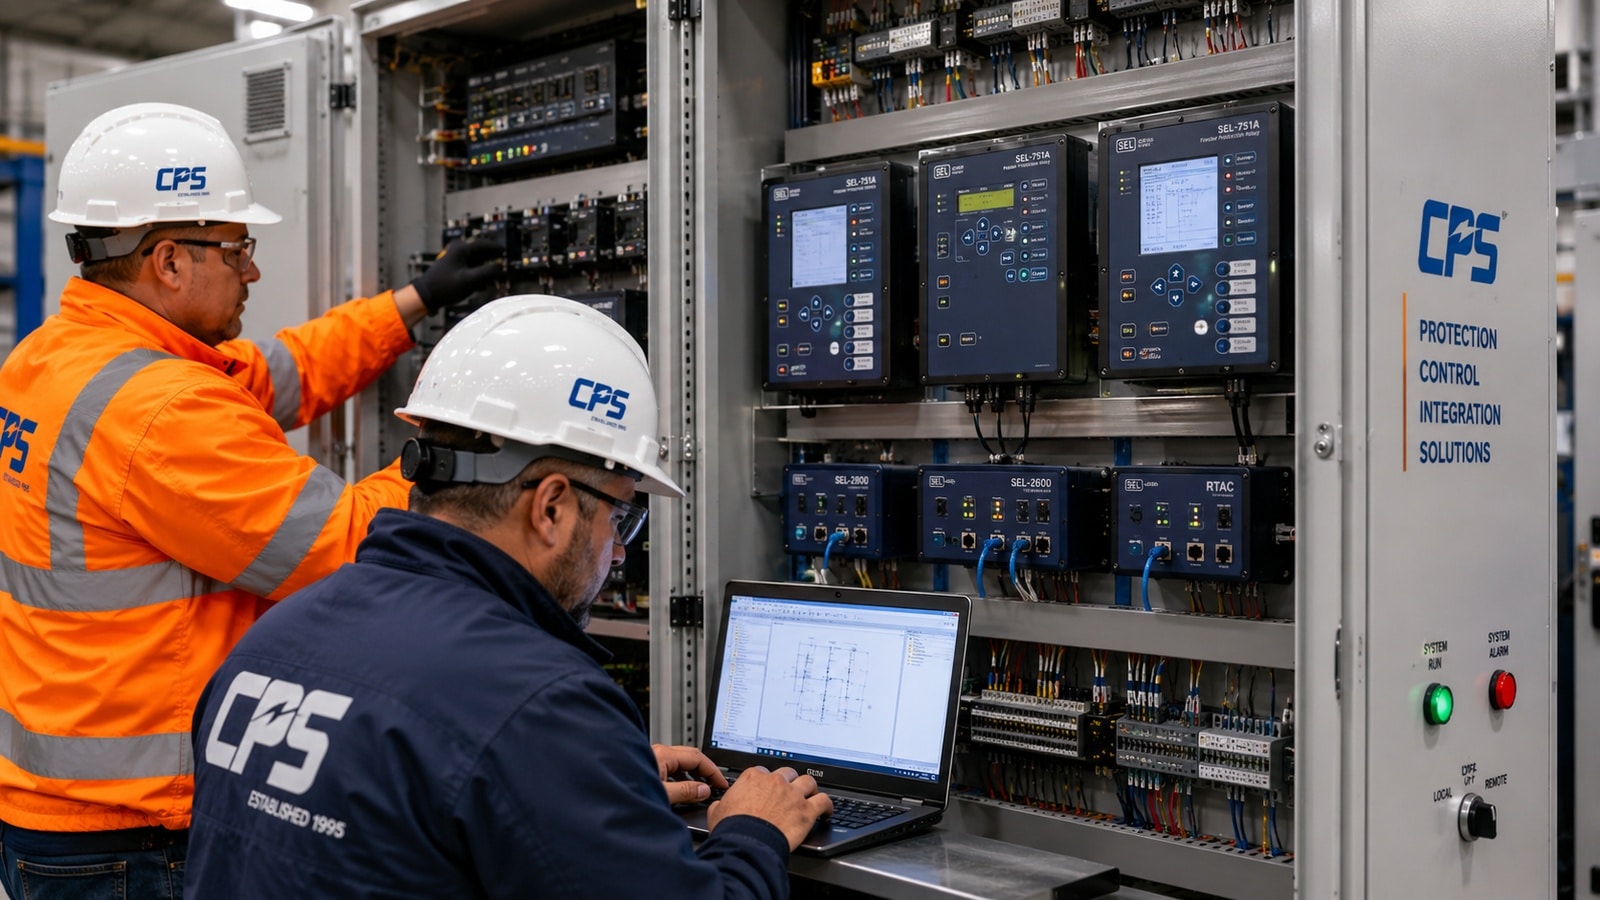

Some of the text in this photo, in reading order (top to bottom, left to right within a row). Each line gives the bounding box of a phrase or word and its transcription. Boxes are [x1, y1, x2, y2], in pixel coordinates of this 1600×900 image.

[1217, 120, 1260, 134] SEL-751A
[1118, 140, 1134, 151] SEL
[1015, 151, 1050, 163] SEL-751A
[155, 166, 207, 192] CPS
[935, 167, 949, 177] SEL
[1418, 199, 1501, 284] CPS
[1419, 319, 1498, 350] PROTECTION
[1419, 360, 1480, 386] CONTROL
[568, 377, 630, 421] CPS
[1419, 400, 1501, 426] INTEGRATION
[0, 406, 38, 474] PS
[1419, 440, 1491, 464] SOLUTIONS
[931, 477, 943, 486] SEL
[1010, 477, 1052, 488] SEL-2600
[1126, 480, 1141, 490] SEL
[1206, 480, 1235, 493] RTAC
[1487, 630, 1511, 644] SYSTEM
[1423, 640, 1448, 655] SYSTEM
[1488, 644, 1510, 659] ALARM
[1428, 657, 1442, 671] RUN
[205, 670, 354, 795] CPS
[1484, 773, 1508, 790] REMOTE
[1432, 787, 1453, 803] LOCAL
[247, 789, 347, 839] ESTABLISHED 1995
